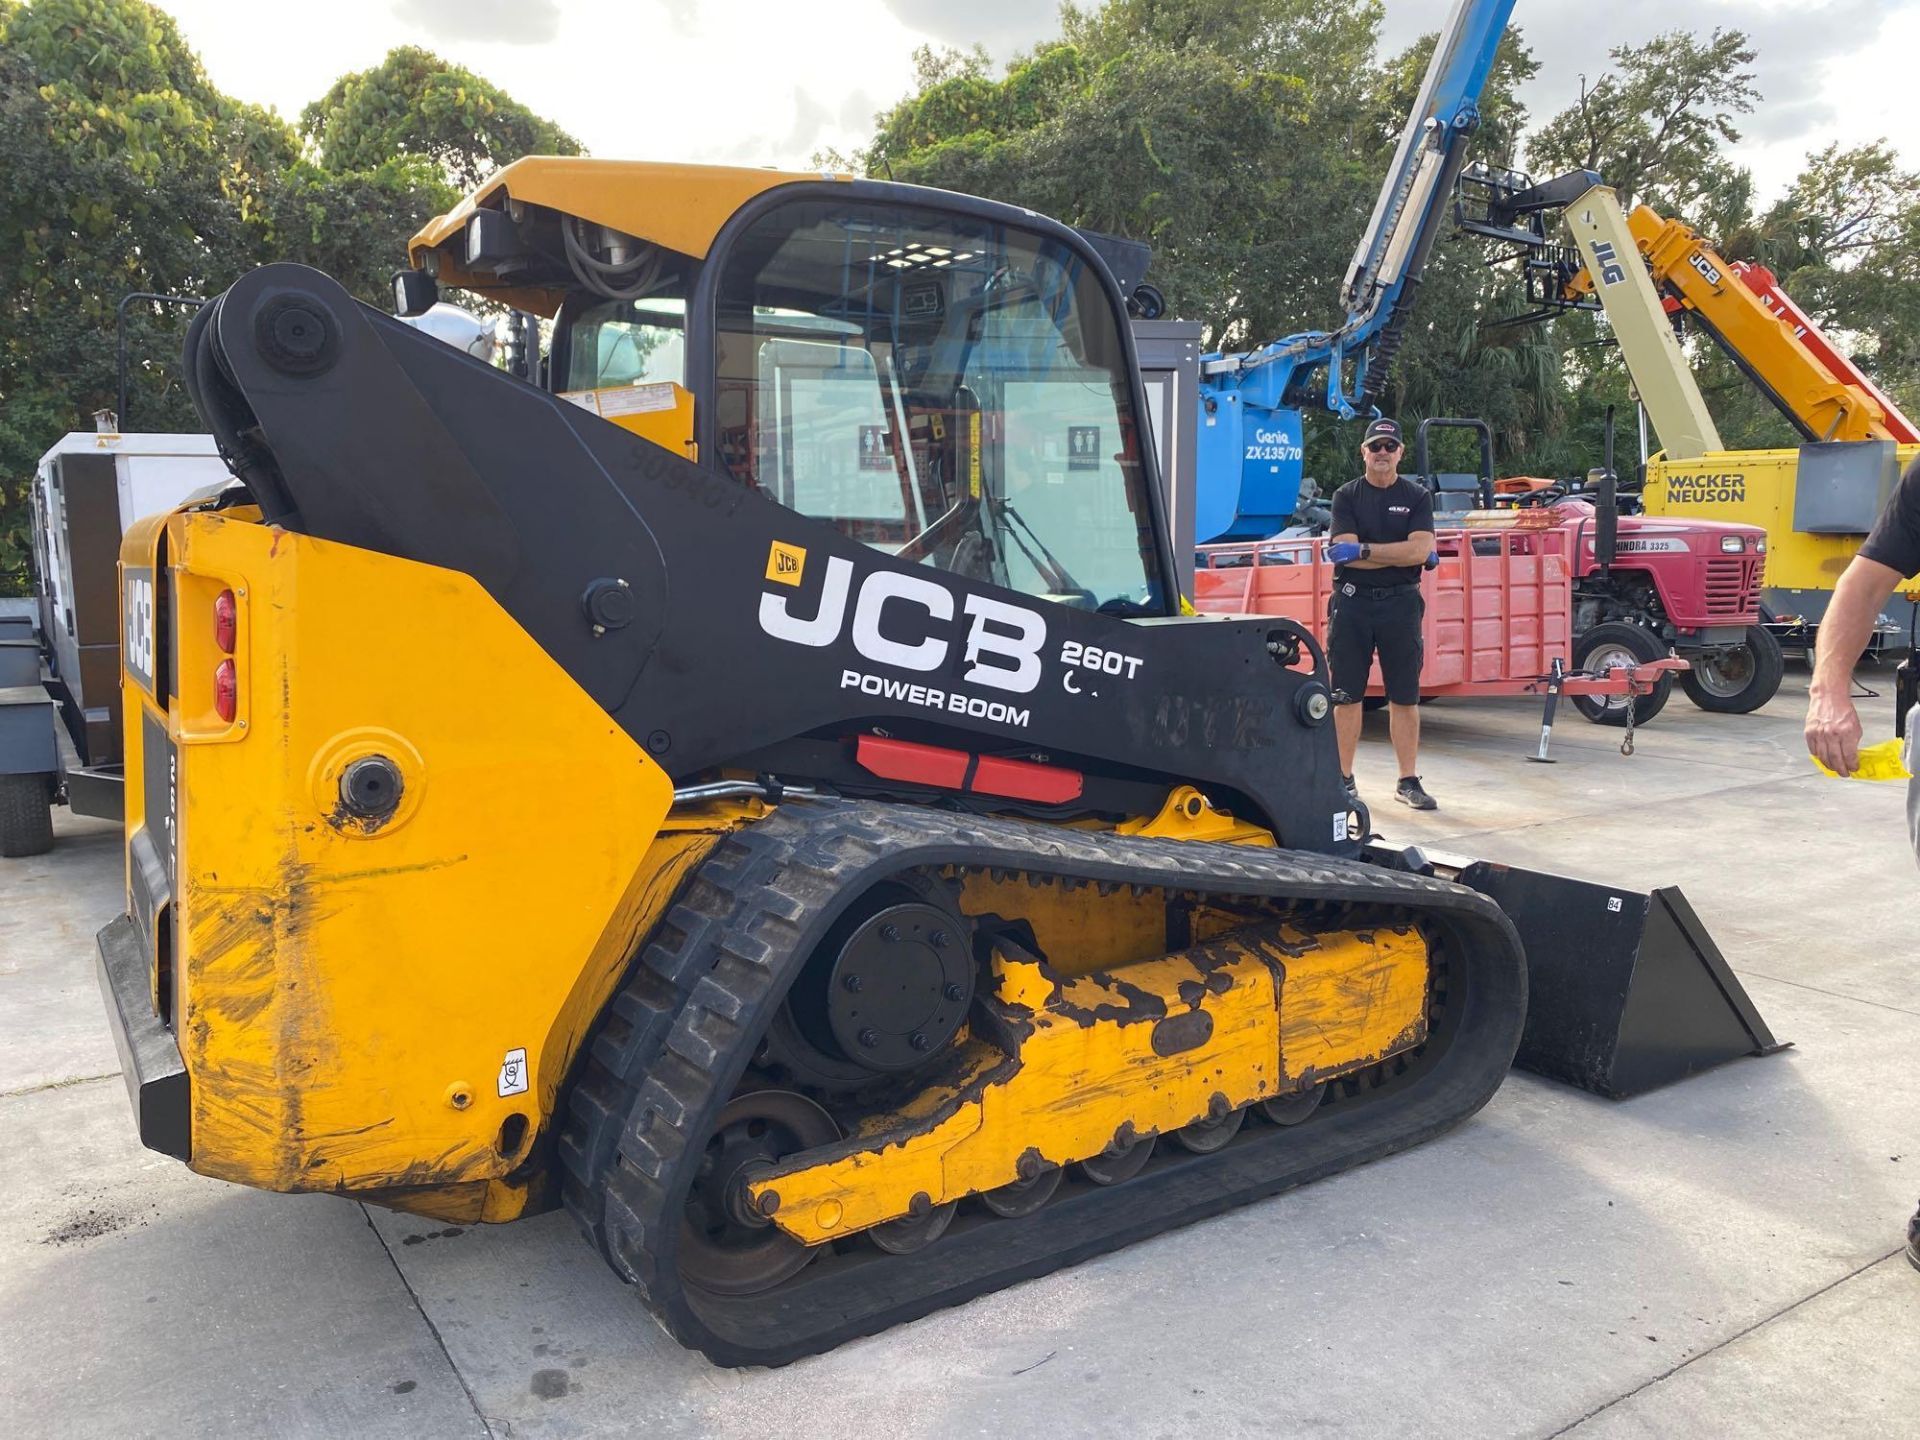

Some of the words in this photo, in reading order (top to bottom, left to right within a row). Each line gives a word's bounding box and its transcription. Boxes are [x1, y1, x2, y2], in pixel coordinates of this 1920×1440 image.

[1590, 240, 1626, 287] JLG
[1688, 249, 1722, 285] JCB
[1256, 428, 1290, 444] Genie
[1245, 446, 1302, 461] ZX-135/70
[1667, 474, 1745, 489] WACKER
[1668, 489, 1745, 503] NEUSON
[1650, 542, 1670, 551] 3325
[778, 553, 797, 571] JCB
[128, 579, 153, 678] JCB
[758, 555, 1047, 693] JCB
[1060, 640, 1144, 681] 260T
[840, 669, 945, 710] POWER
[947, 693, 1030, 728] BOOM
